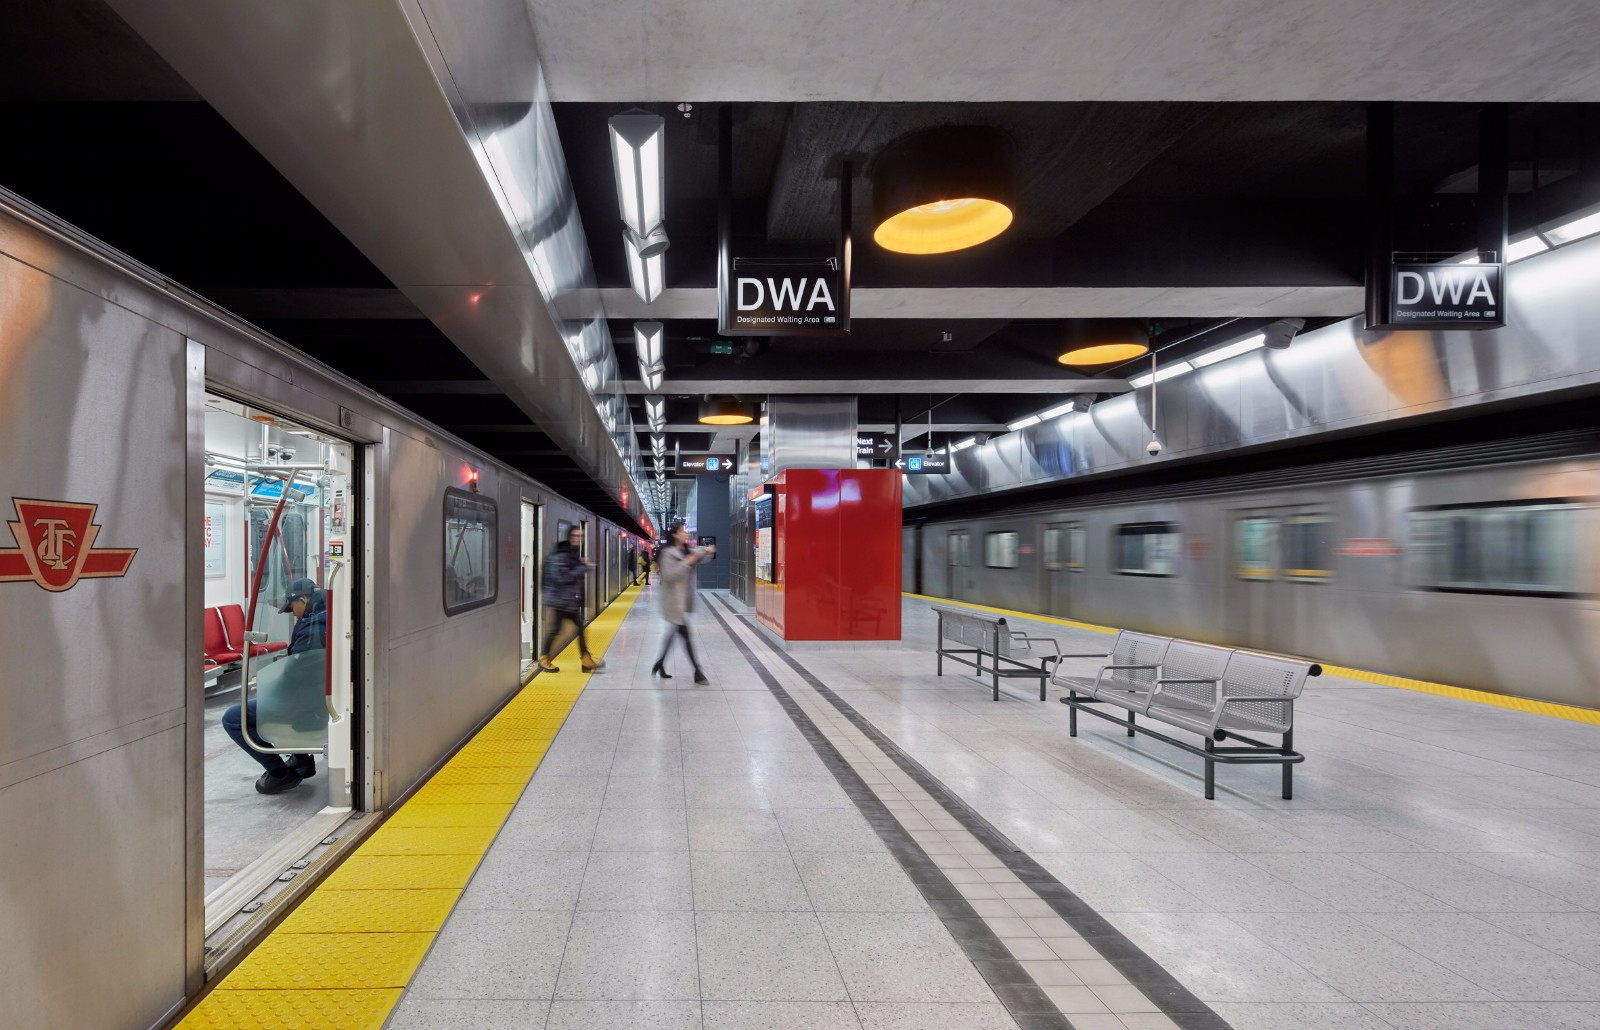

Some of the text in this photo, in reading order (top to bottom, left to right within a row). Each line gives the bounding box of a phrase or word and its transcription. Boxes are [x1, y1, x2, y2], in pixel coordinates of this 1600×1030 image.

[1397, 271, 1496, 305] DWA
[737, 277, 836, 311] DWA
[1397, 310, 1435, 318] Designated
[1437, 310, 1463, 318] Waiting
[737, 316, 775, 324] Designated
[777, 316, 802, 324] Waiting
[856, 437, 873, 445] Next
[856, 446, 874, 454] Train
